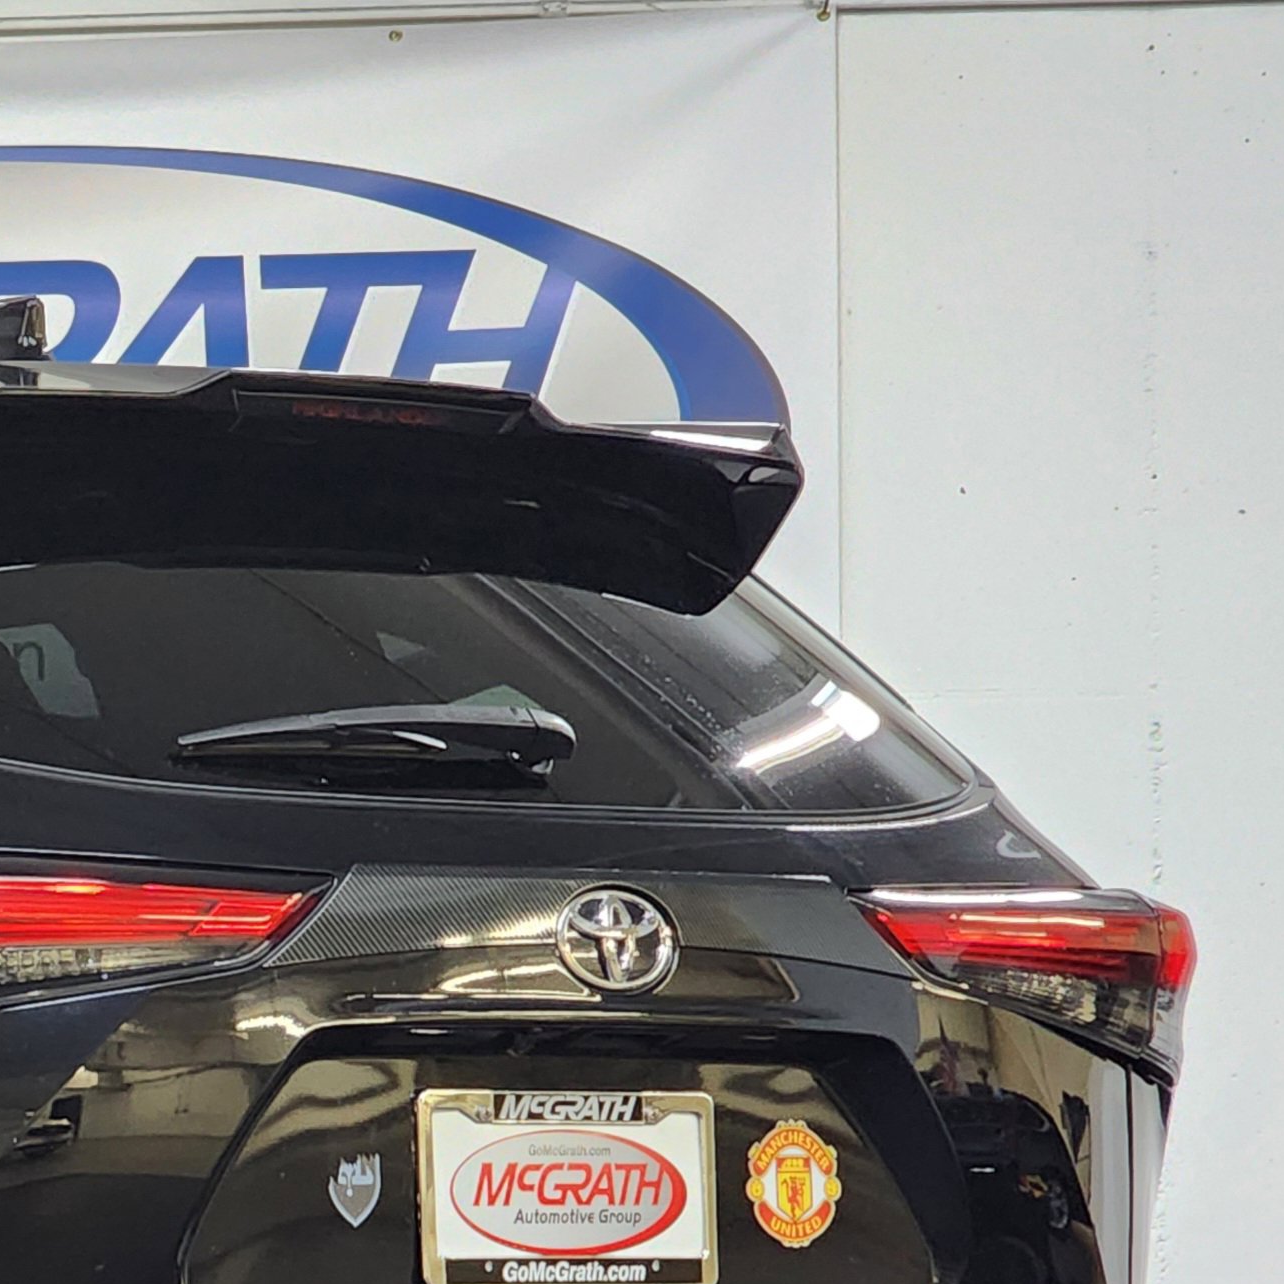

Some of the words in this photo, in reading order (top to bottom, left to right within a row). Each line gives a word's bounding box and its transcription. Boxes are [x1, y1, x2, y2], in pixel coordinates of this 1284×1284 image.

[528, 1143, 612, 1157] GoMcGrath.com
[756, 1130, 831, 1171] MANCHESTER
[513, 1208, 595, 1225] Automotive
[598, 1208, 642, 1227] Group
[770, 1215, 823, 1238] UNITED
[501, 1260, 647, 1283] GoMcGrath.com
